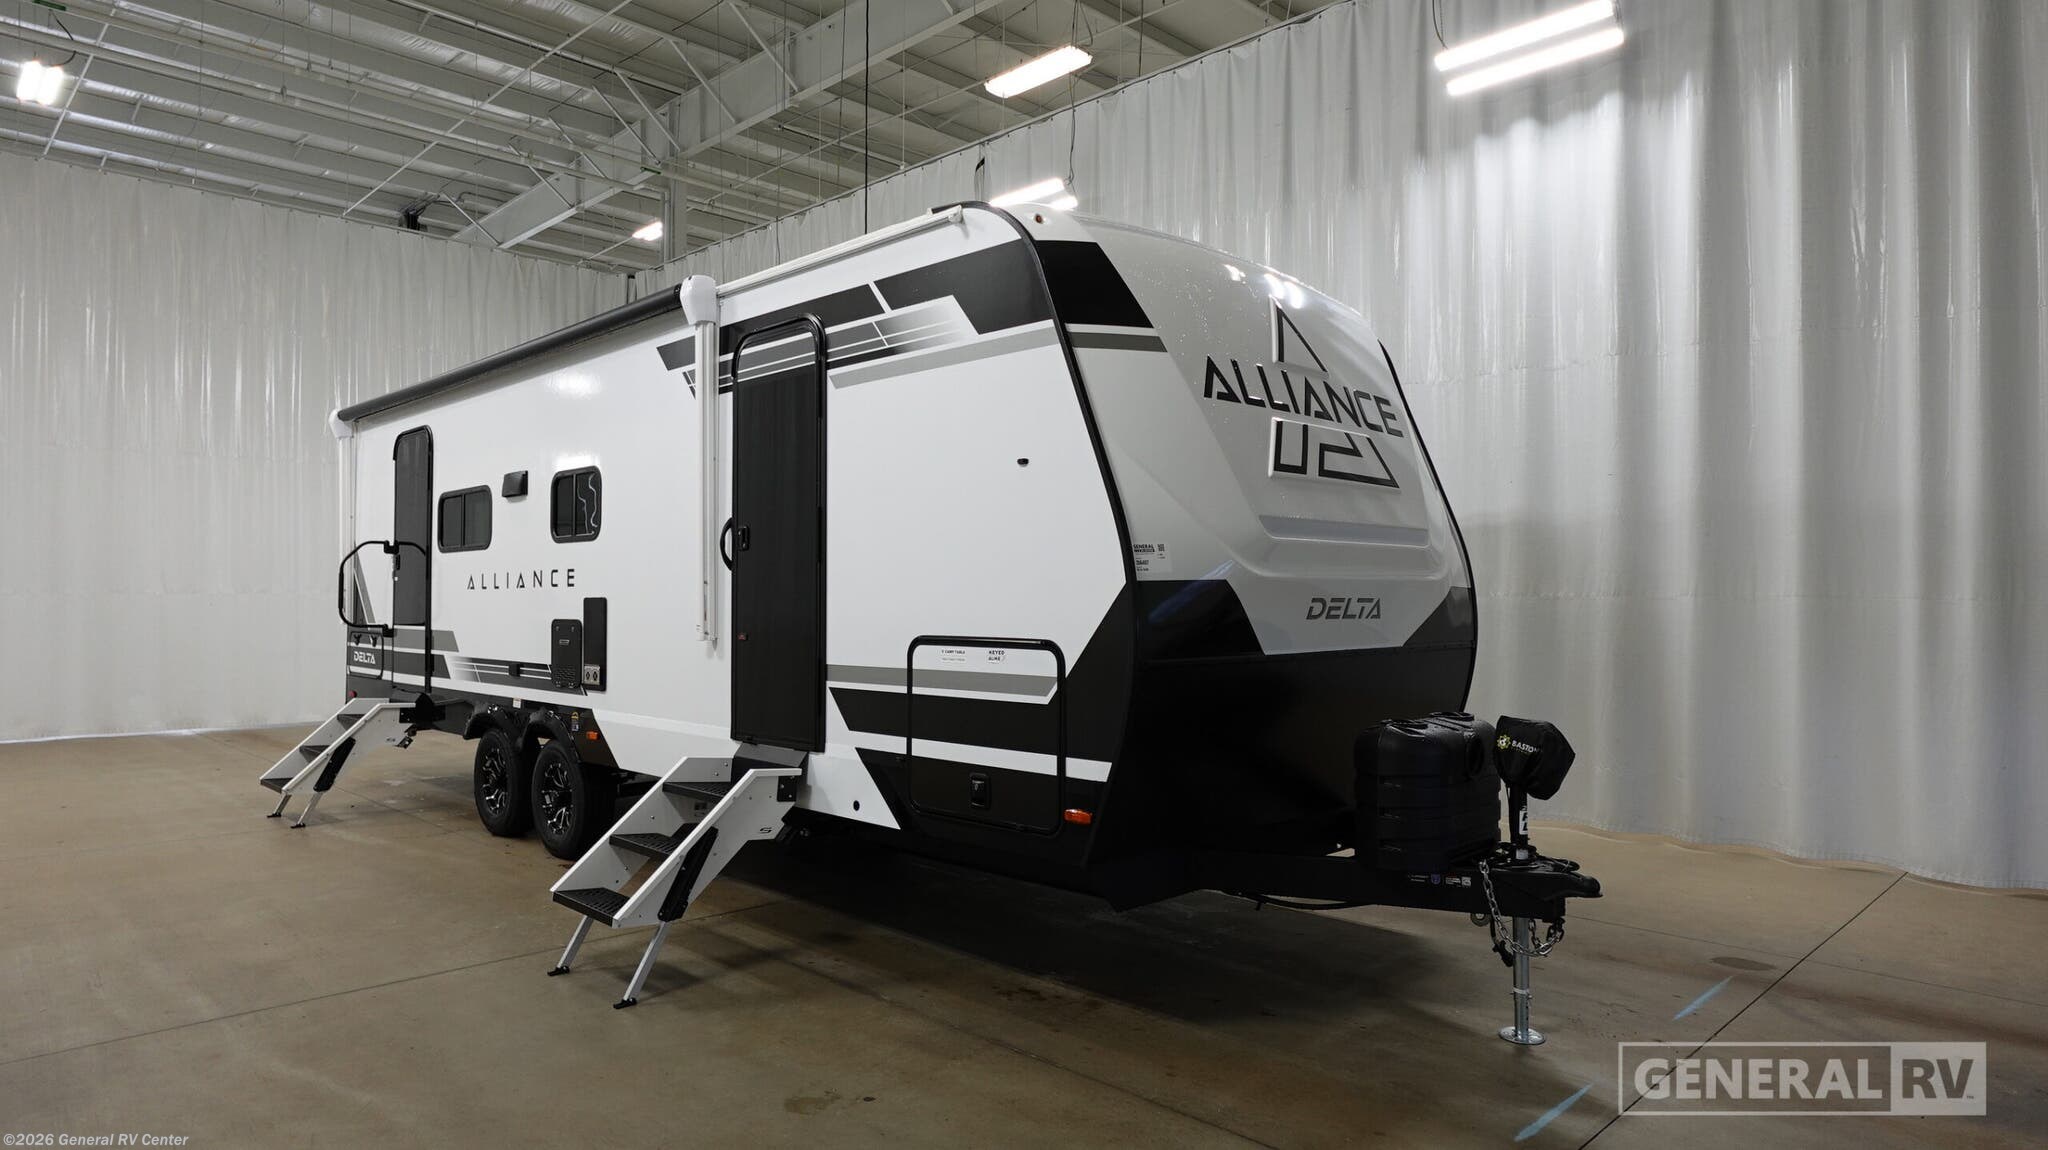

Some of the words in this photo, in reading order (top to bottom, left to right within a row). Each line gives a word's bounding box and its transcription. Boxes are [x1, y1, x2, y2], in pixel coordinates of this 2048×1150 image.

[1203, 354, 1404, 437] ALLIANCE
[467, 568, 575, 590] ALLIANCE
[1306, 597, 1381, 620] DELTA
[353, 650, 376, 665] DELTA
